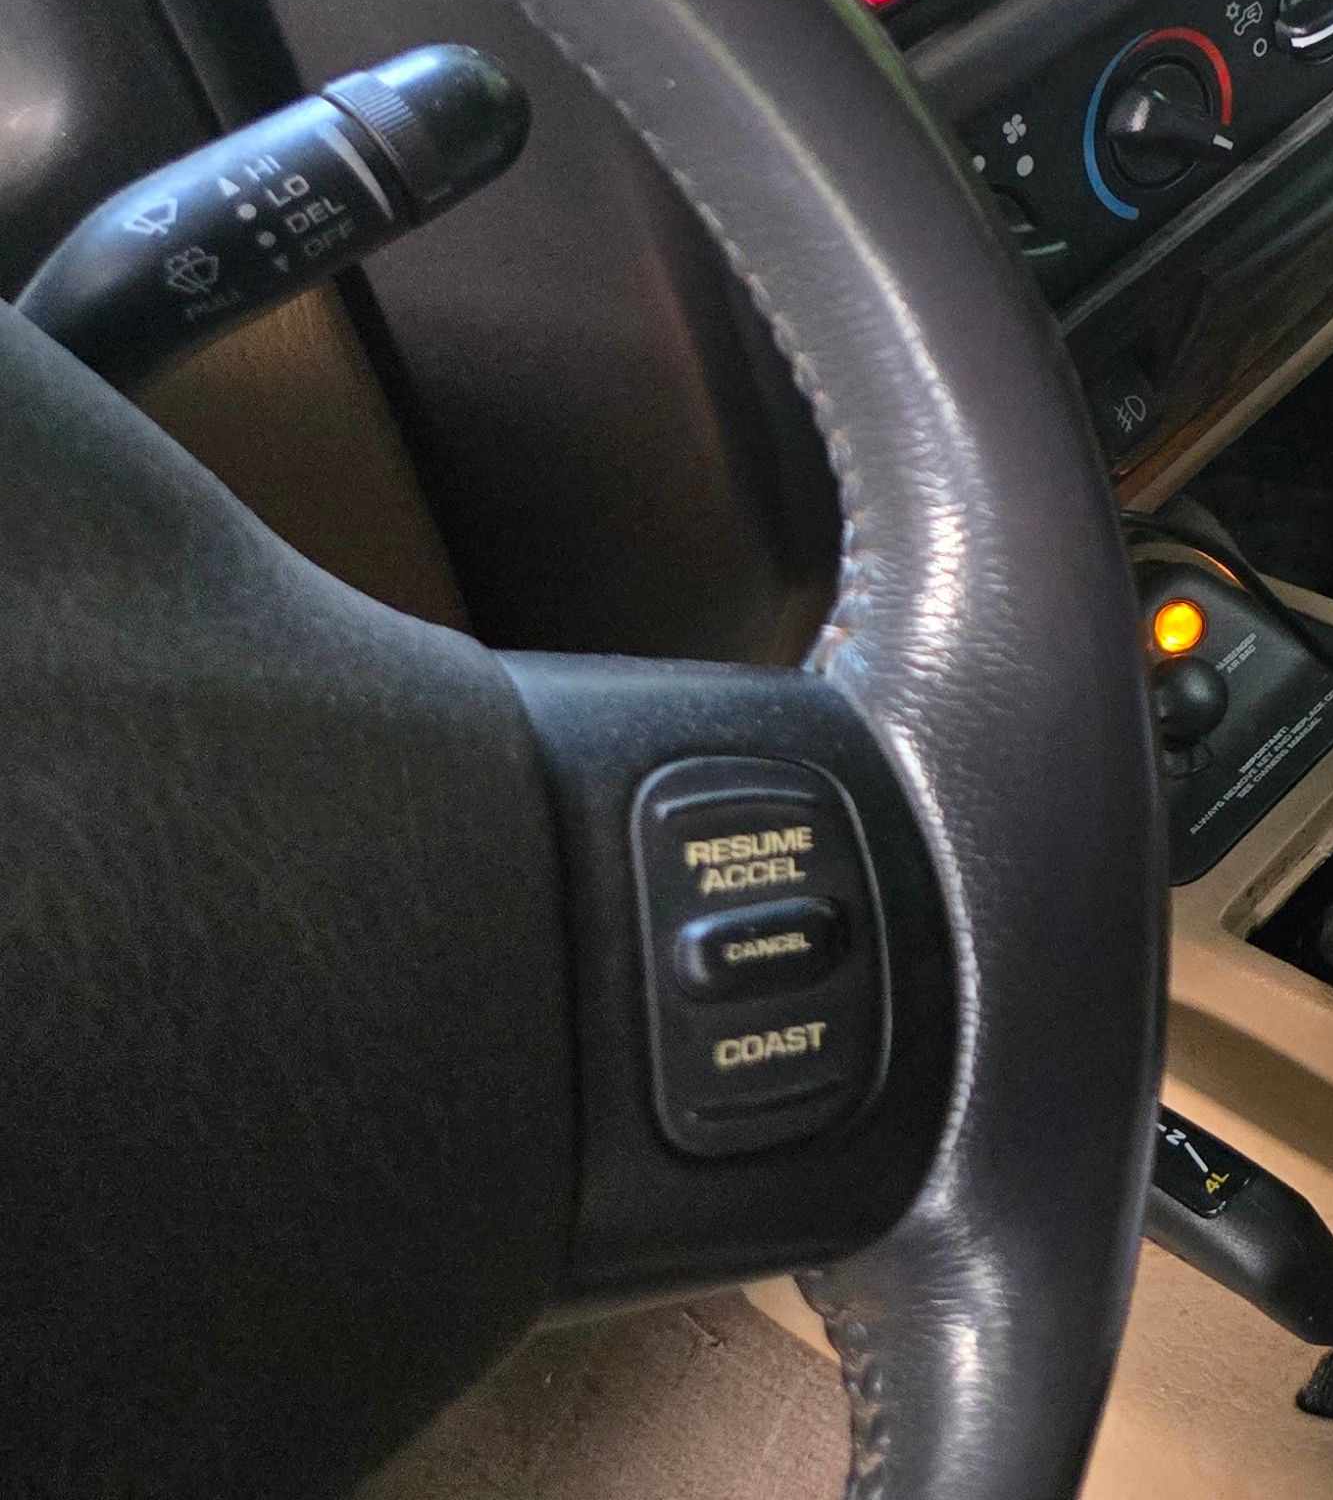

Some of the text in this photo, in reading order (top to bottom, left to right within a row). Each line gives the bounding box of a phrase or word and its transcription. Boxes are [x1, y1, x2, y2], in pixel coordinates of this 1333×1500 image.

[244, 154, 282, 182] HI
[265, 173, 311, 208] LO
[285, 197, 346, 235] DEL
[1190, 800, 1226, 835] ALWAYS
[684, 825, 814, 868] RESUME
[701, 856, 808, 896] ACCEL
[724, 931, 812, 964] CANCEL
[713, 1021, 828, 1070] COAST
[1205, 1172, 1231, 1195] 4L
